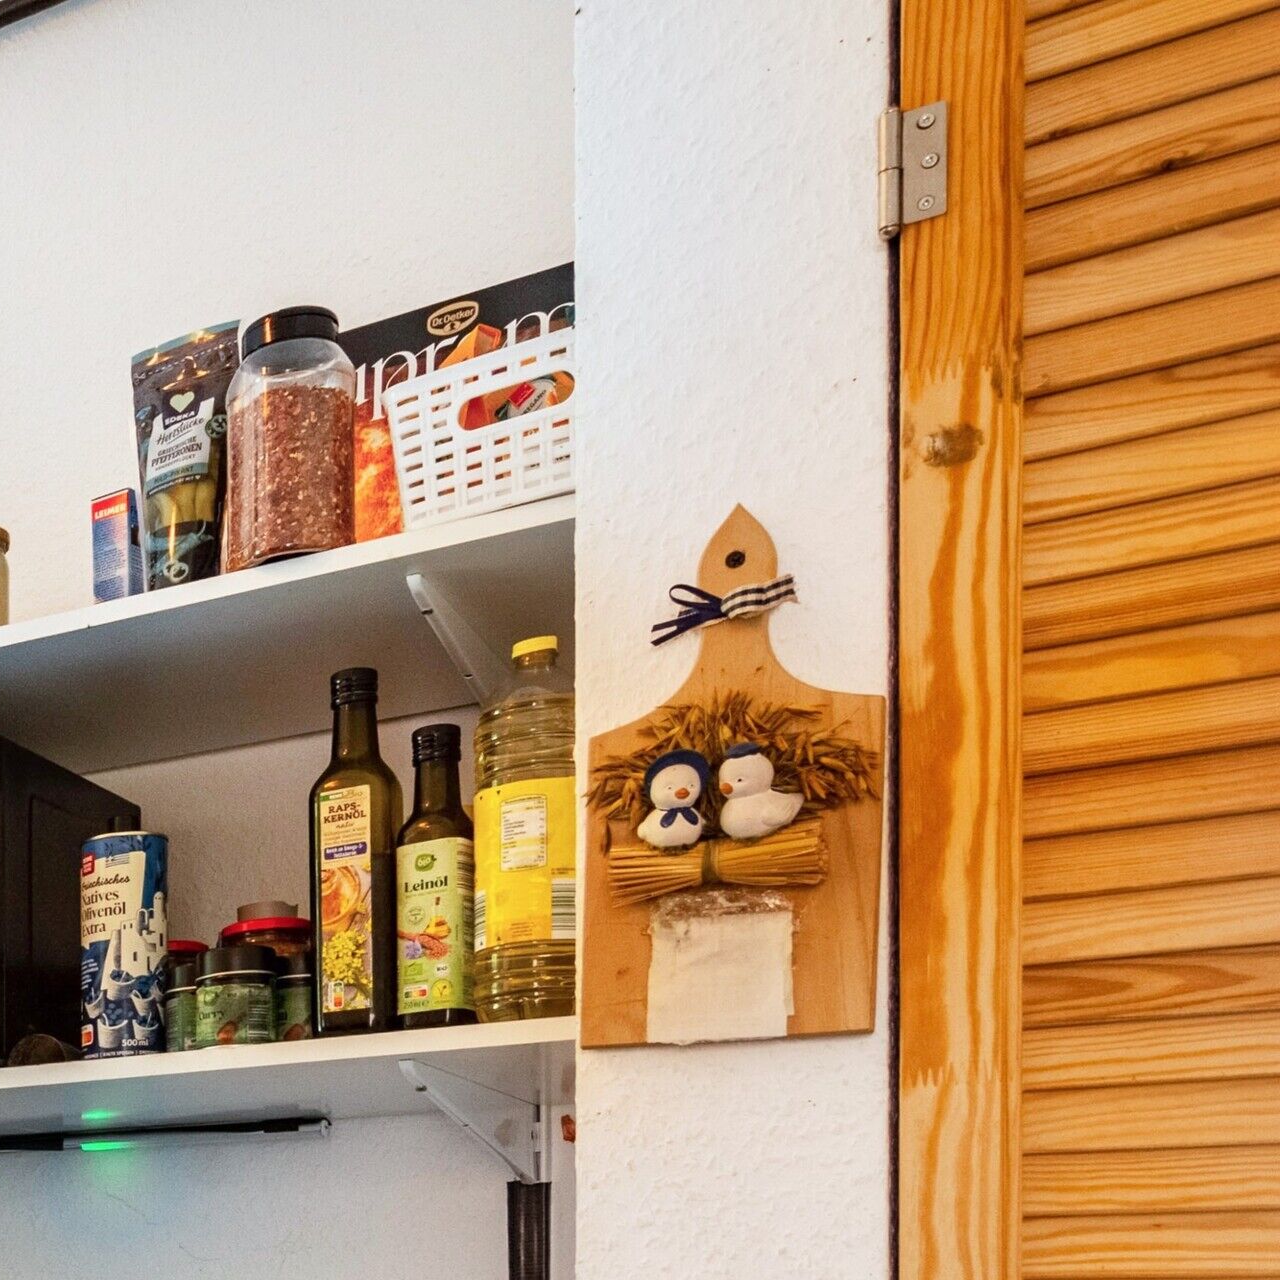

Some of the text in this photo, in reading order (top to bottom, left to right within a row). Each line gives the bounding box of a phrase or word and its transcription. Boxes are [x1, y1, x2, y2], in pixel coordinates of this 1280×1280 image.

[328, 801, 361, 814] RAPS-
[323, 809, 367, 823] KERNÖL
[404, 875, 448, 893] Leinöl
[121, 1039, 138, 1047] 500
